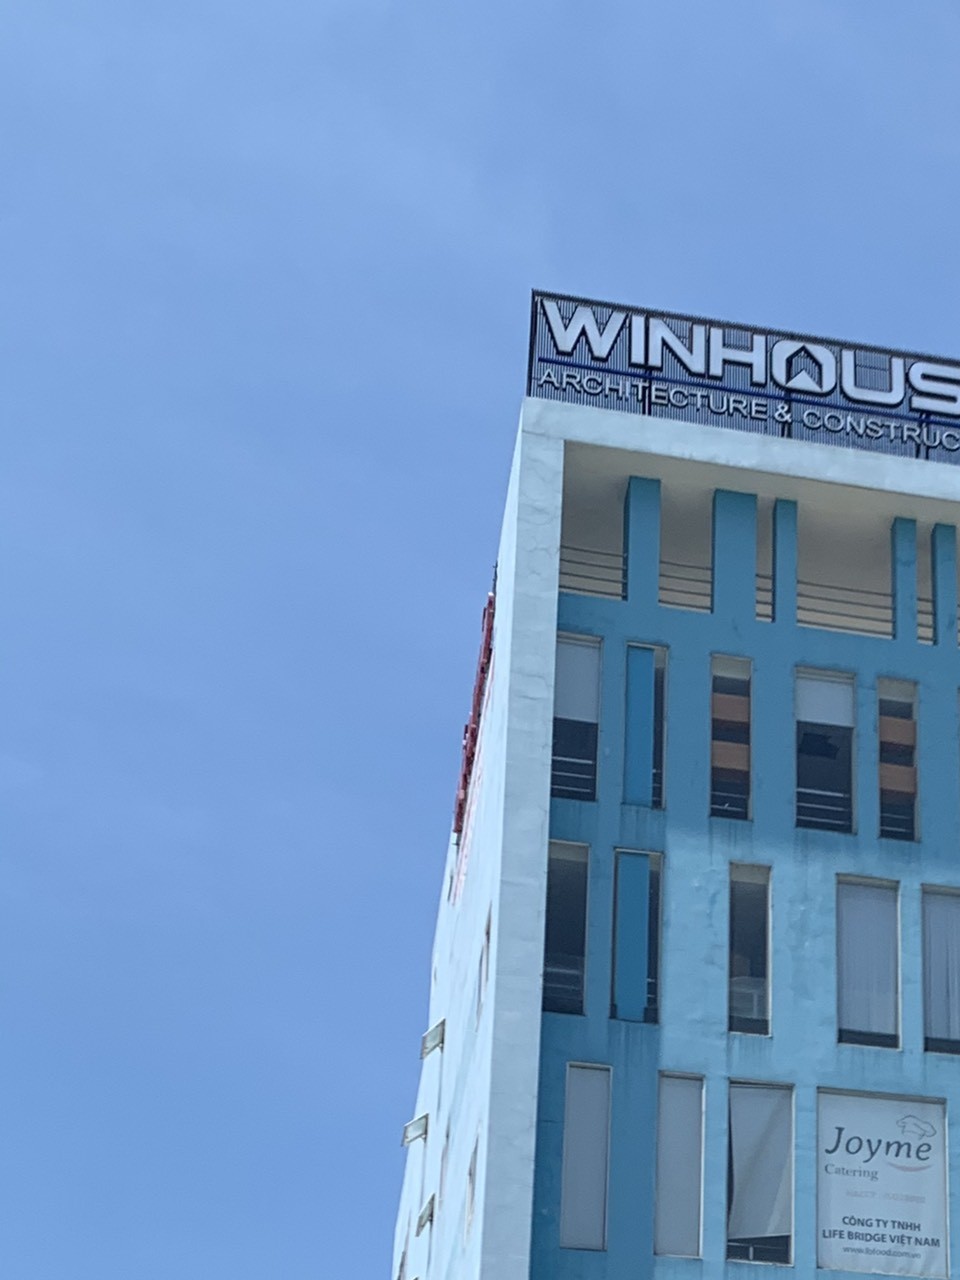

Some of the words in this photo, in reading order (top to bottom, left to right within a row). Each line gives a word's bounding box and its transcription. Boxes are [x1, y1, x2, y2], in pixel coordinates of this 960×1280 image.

[537, 368, 769, 420] ARCHITECTURE
[774, 403, 793, 423] &
[824, 1126, 932, 1163] Joyme
[824, 1163, 879, 1181] Catering
[842, 1215, 873, 1228] CÔNG
[875, 1218, 889, 1229] TY
[891, 1219, 921, 1232] TNHH
[822, 1229, 845, 1240] LIFE
[848, 1231, 887, 1243] BRIDGE
[889, 1233, 912, 1248] VIỆT
[914, 1236, 940, 1248] NAM
